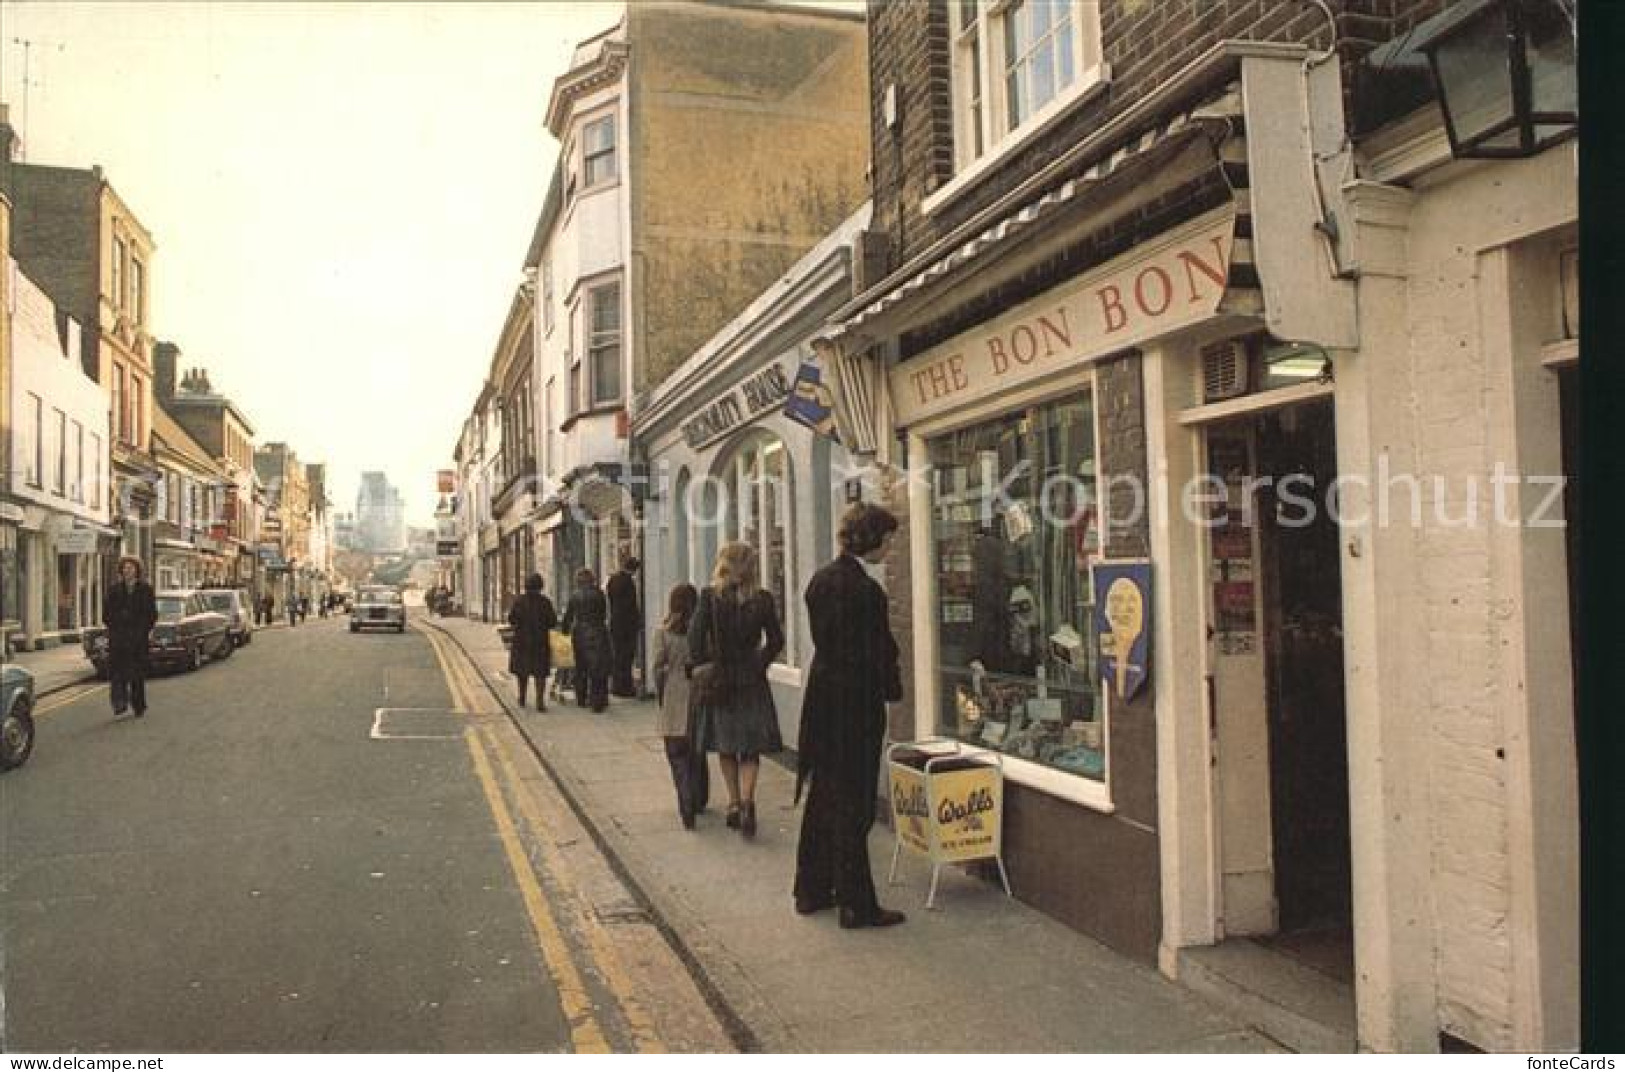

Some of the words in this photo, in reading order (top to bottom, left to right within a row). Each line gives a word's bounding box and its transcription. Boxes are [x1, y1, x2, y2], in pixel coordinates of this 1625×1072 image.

[910, 354, 968, 405] THE
[988, 308, 1072, 376] BON
[1097, 236, 1229, 333] BON
